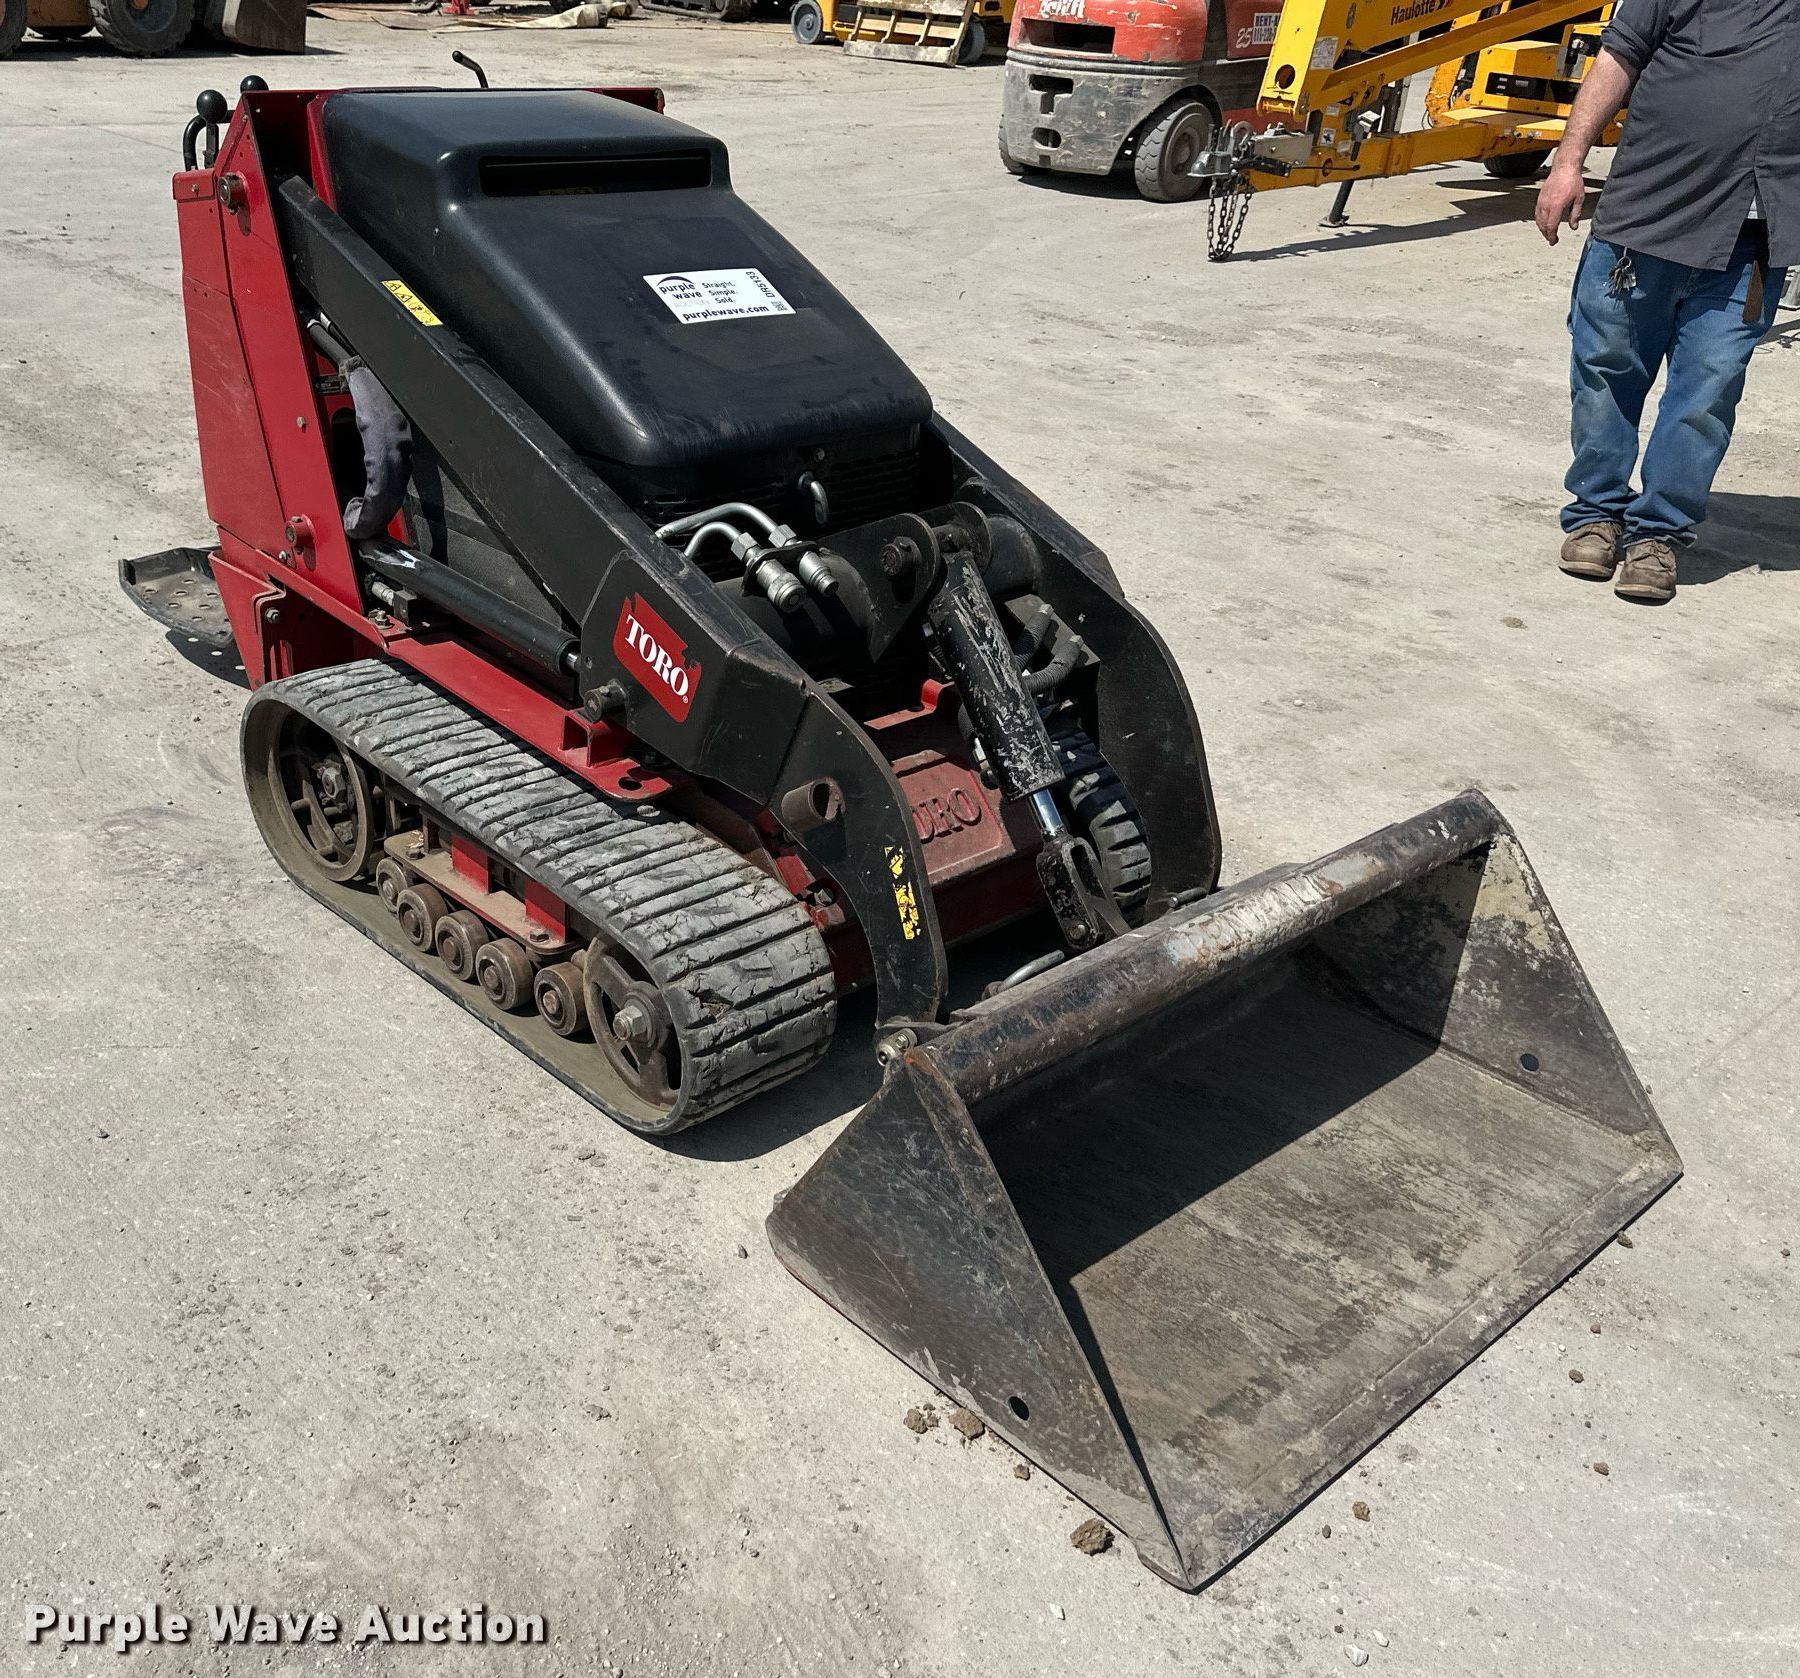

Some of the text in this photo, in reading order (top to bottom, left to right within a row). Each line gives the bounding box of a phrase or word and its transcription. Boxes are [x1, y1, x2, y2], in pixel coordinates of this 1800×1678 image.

[1390, 0, 1436, 25] Haulotte
[1236, 27, 1253, 49] 25
[659, 282, 695, 294] purple
[701, 281, 736, 290] Straight.
[673, 291, 702, 300] wave
[708, 289, 738, 297] Simple.
[714, 296, 735, 304] Sold.
[682, 305, 770, 321] purplewave.com
[624, 613, 689, 696] TORO
[911, 787, 982, 844] ORO
